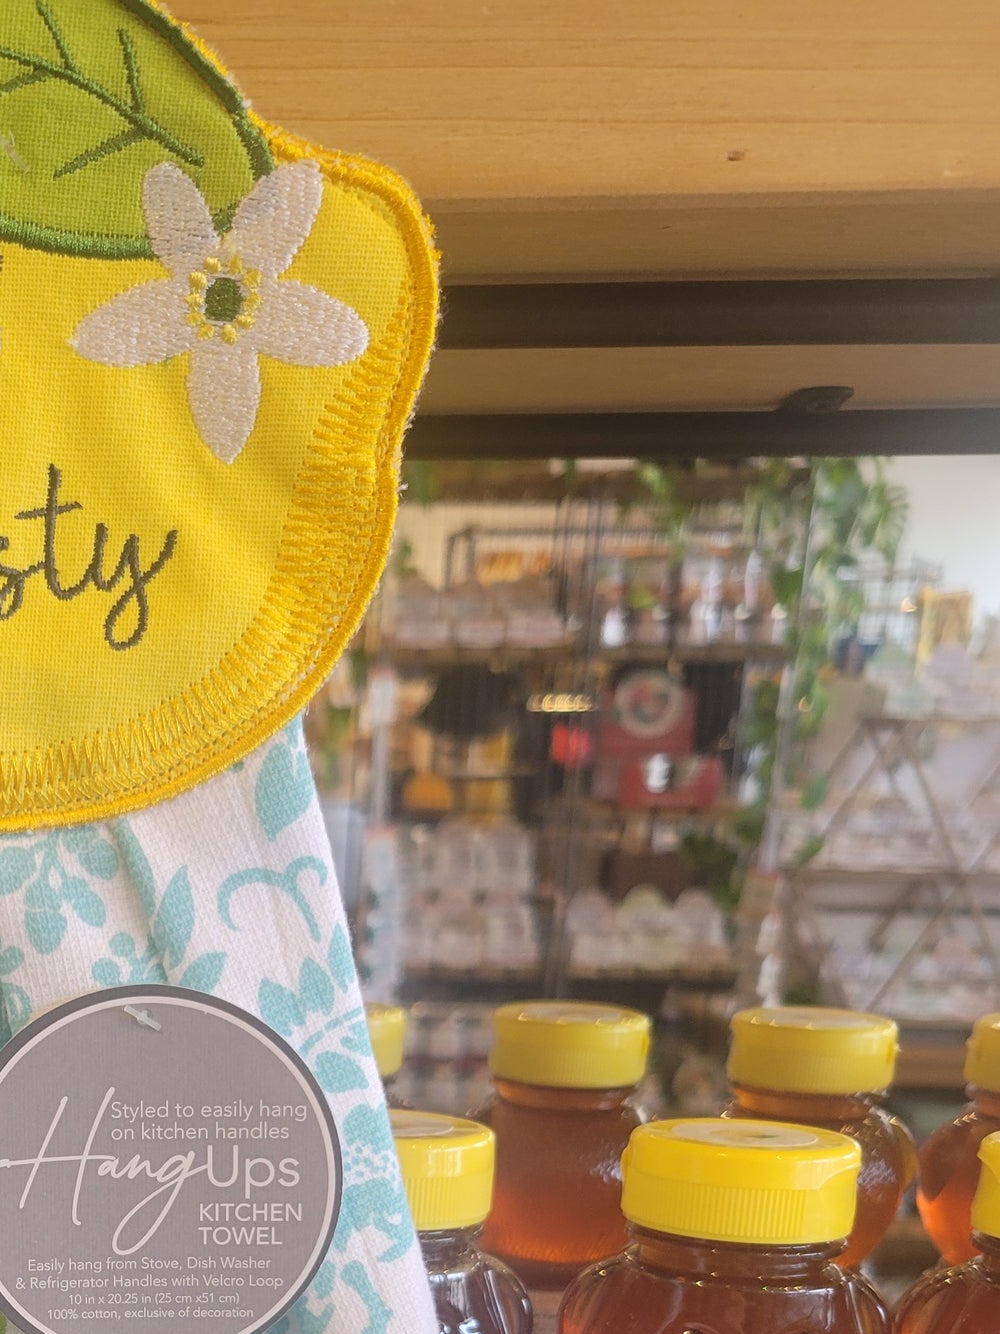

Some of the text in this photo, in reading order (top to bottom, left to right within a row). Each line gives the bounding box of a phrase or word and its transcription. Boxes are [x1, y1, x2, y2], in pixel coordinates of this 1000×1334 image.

[111, 1099, 307, 1123] Styled to easily hang
[111, 1121, 289, 1141] on kitchen handles
[199, 1202, 302, 1222] KITCHEN
[198, 1226, 284, 1246] TOWEL
[28, 1255, 272, 1273] Easily hang from Stove, Dish Washer
[15, 1274, 284, 1291] & Refrigerator Handles with Velcro Loop
[68, 1292, 240, 1305] 10 in x 20.25 in (25 cm x51 cm)
[47, 1307, 254, 1321] 100% cotton, exclusive of decoration
